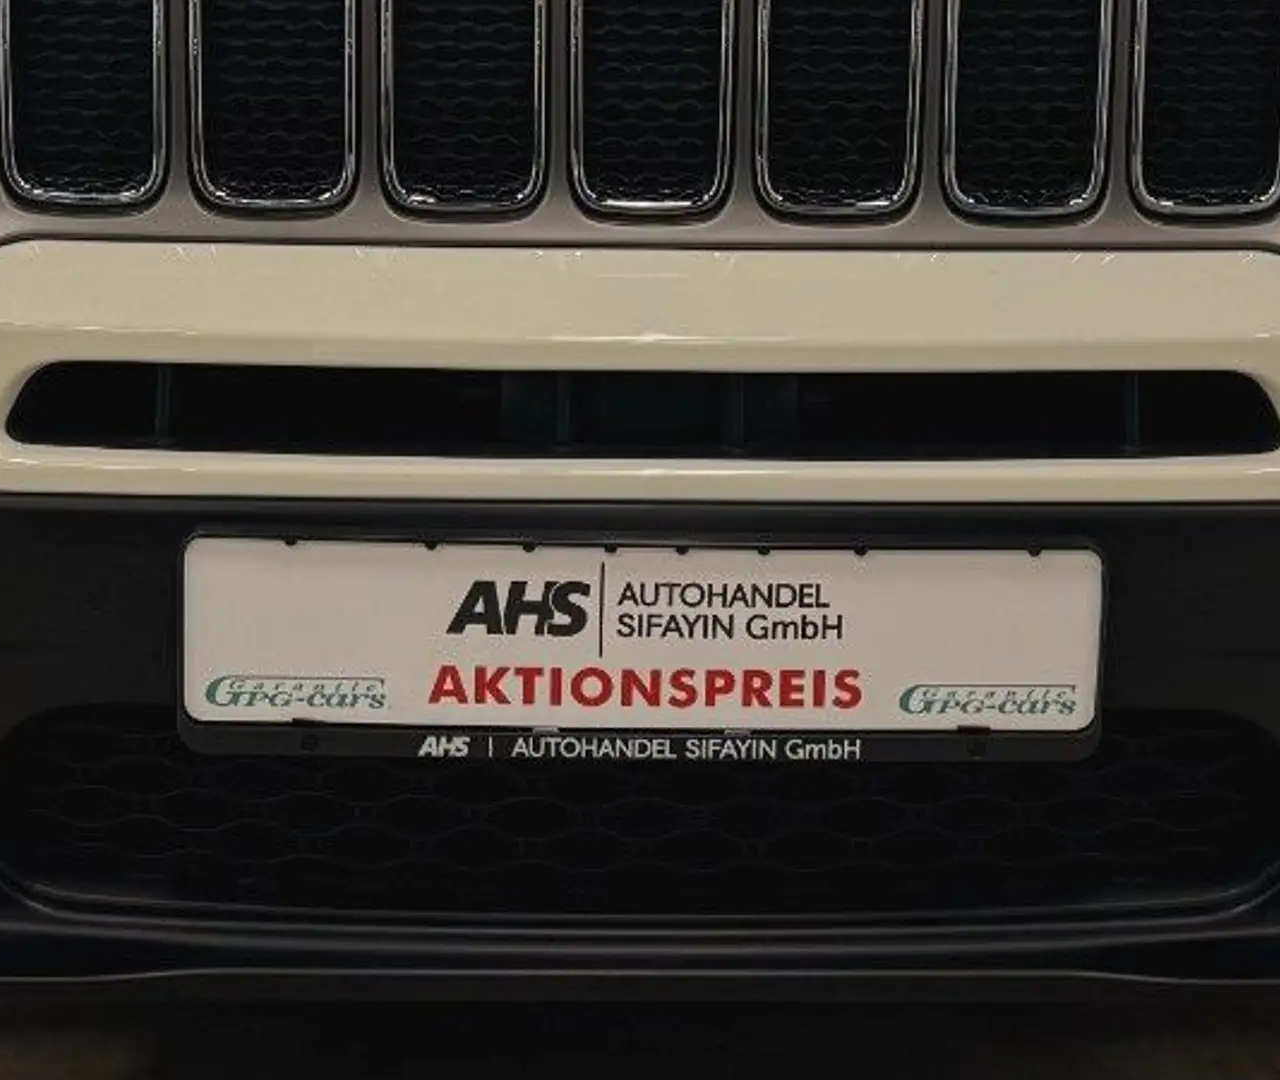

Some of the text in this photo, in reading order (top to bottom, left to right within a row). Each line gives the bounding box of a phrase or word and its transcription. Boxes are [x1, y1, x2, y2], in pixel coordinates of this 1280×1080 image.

[446, 579, 591, 637] AHS
[617, 582, 831, 609] AUTOHANDEL
[616, 613, 843, 640] SIFAYIN GmbH
[428, 664, 864, 709] AKTIONSPREIS
[418, 735, 862, 760] AHS AUTOHANDEL SIFAYIN GmbH
